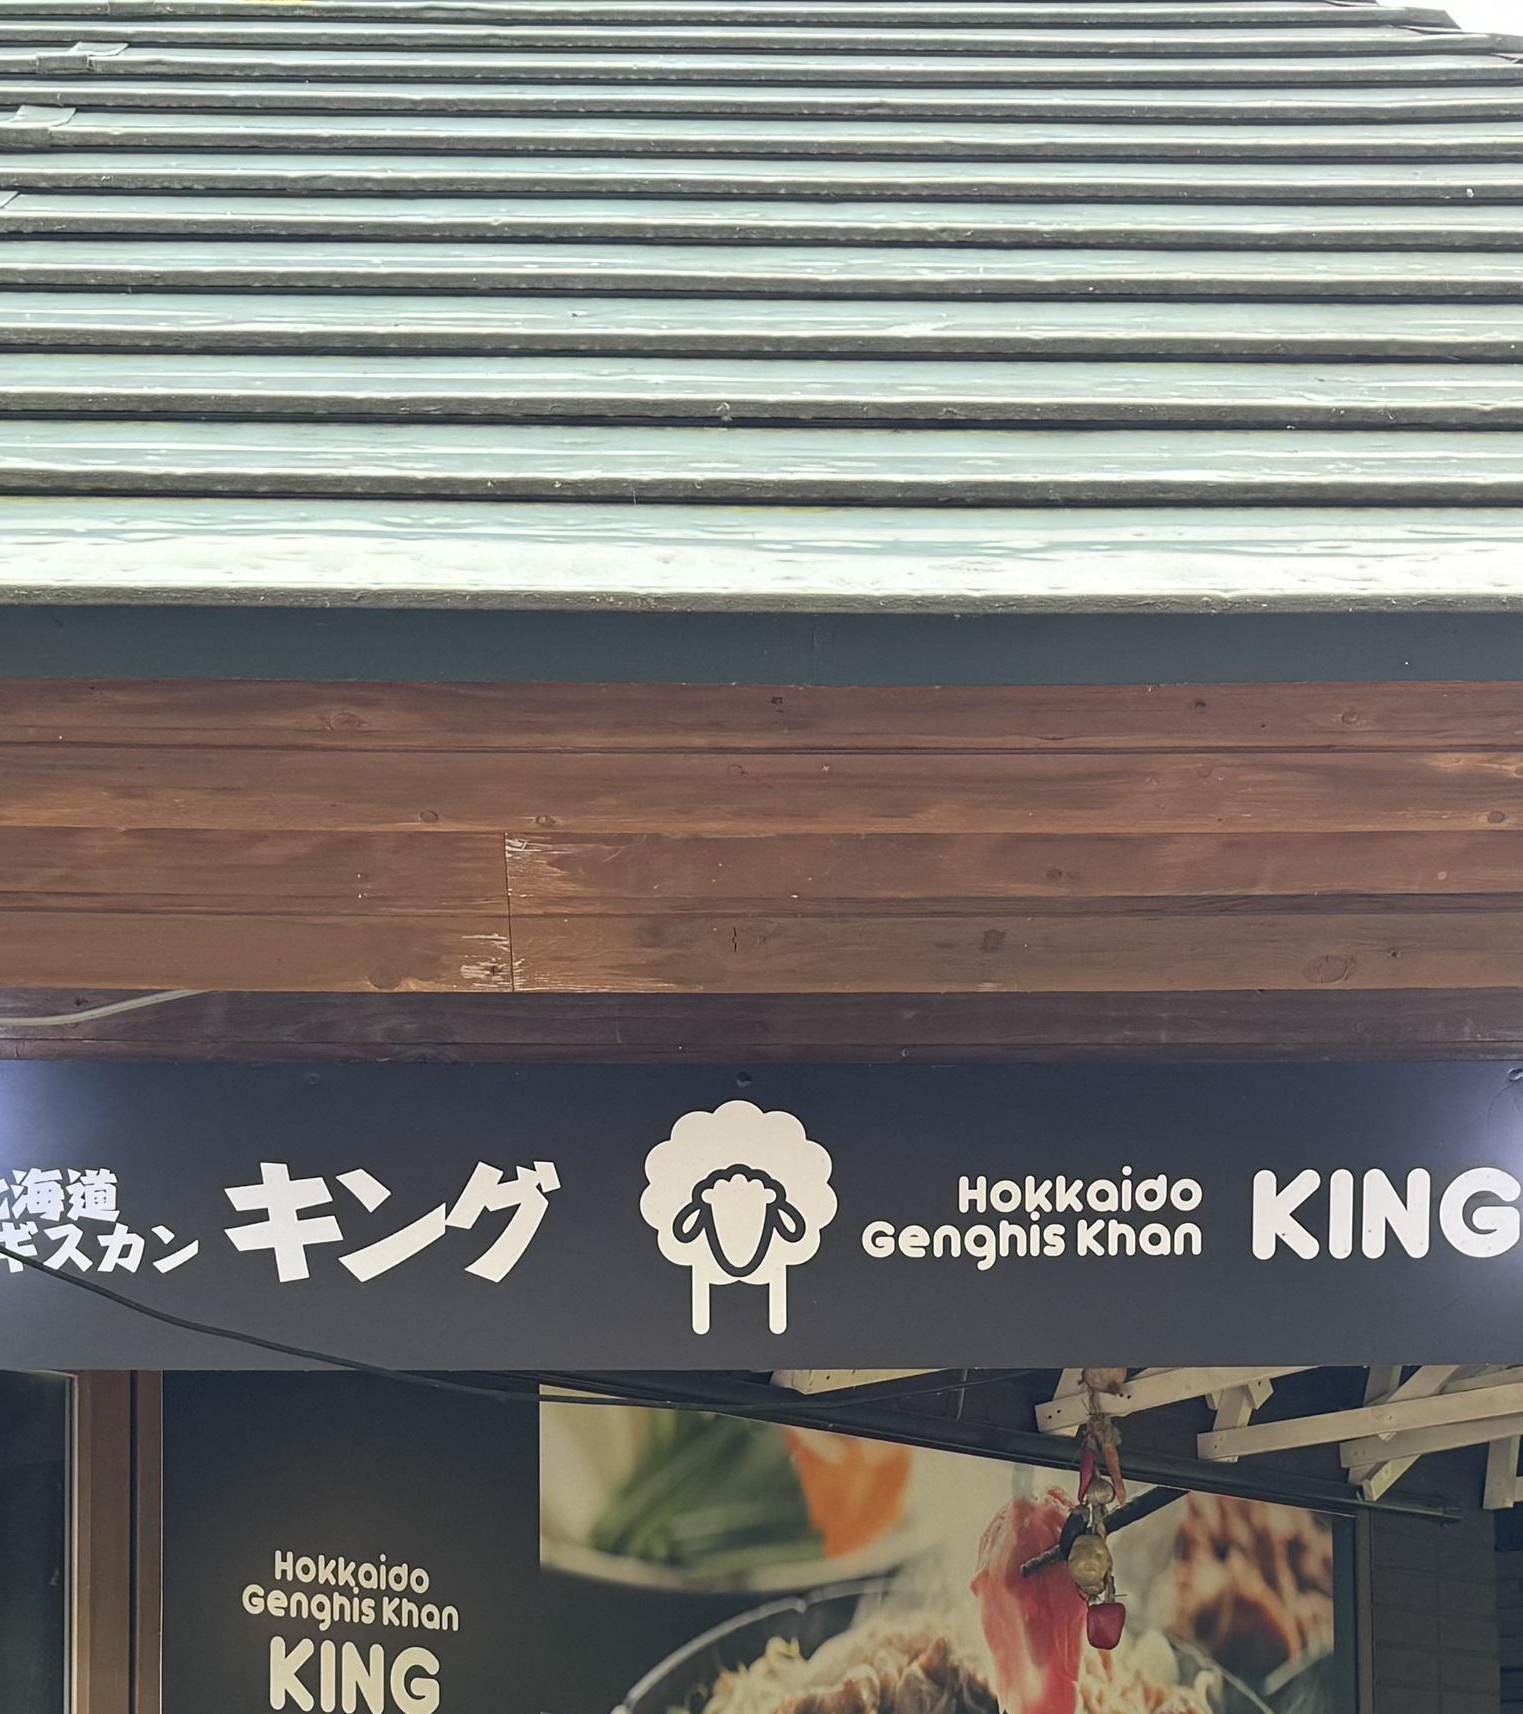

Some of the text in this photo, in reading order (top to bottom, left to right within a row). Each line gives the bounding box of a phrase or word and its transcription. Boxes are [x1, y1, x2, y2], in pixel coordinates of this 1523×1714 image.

[959, 1165, 1203, 1213] Hokkaido
[1253, 1168, 1521, 1259] KING
[225, 1162, 560, 1282] キング
[862, 1211, 1202, 1271] Genghis Khan
[274, 1550, 430, 1594] Hokkaido
[242, 1584, 460, 1631] Genghis Khan
